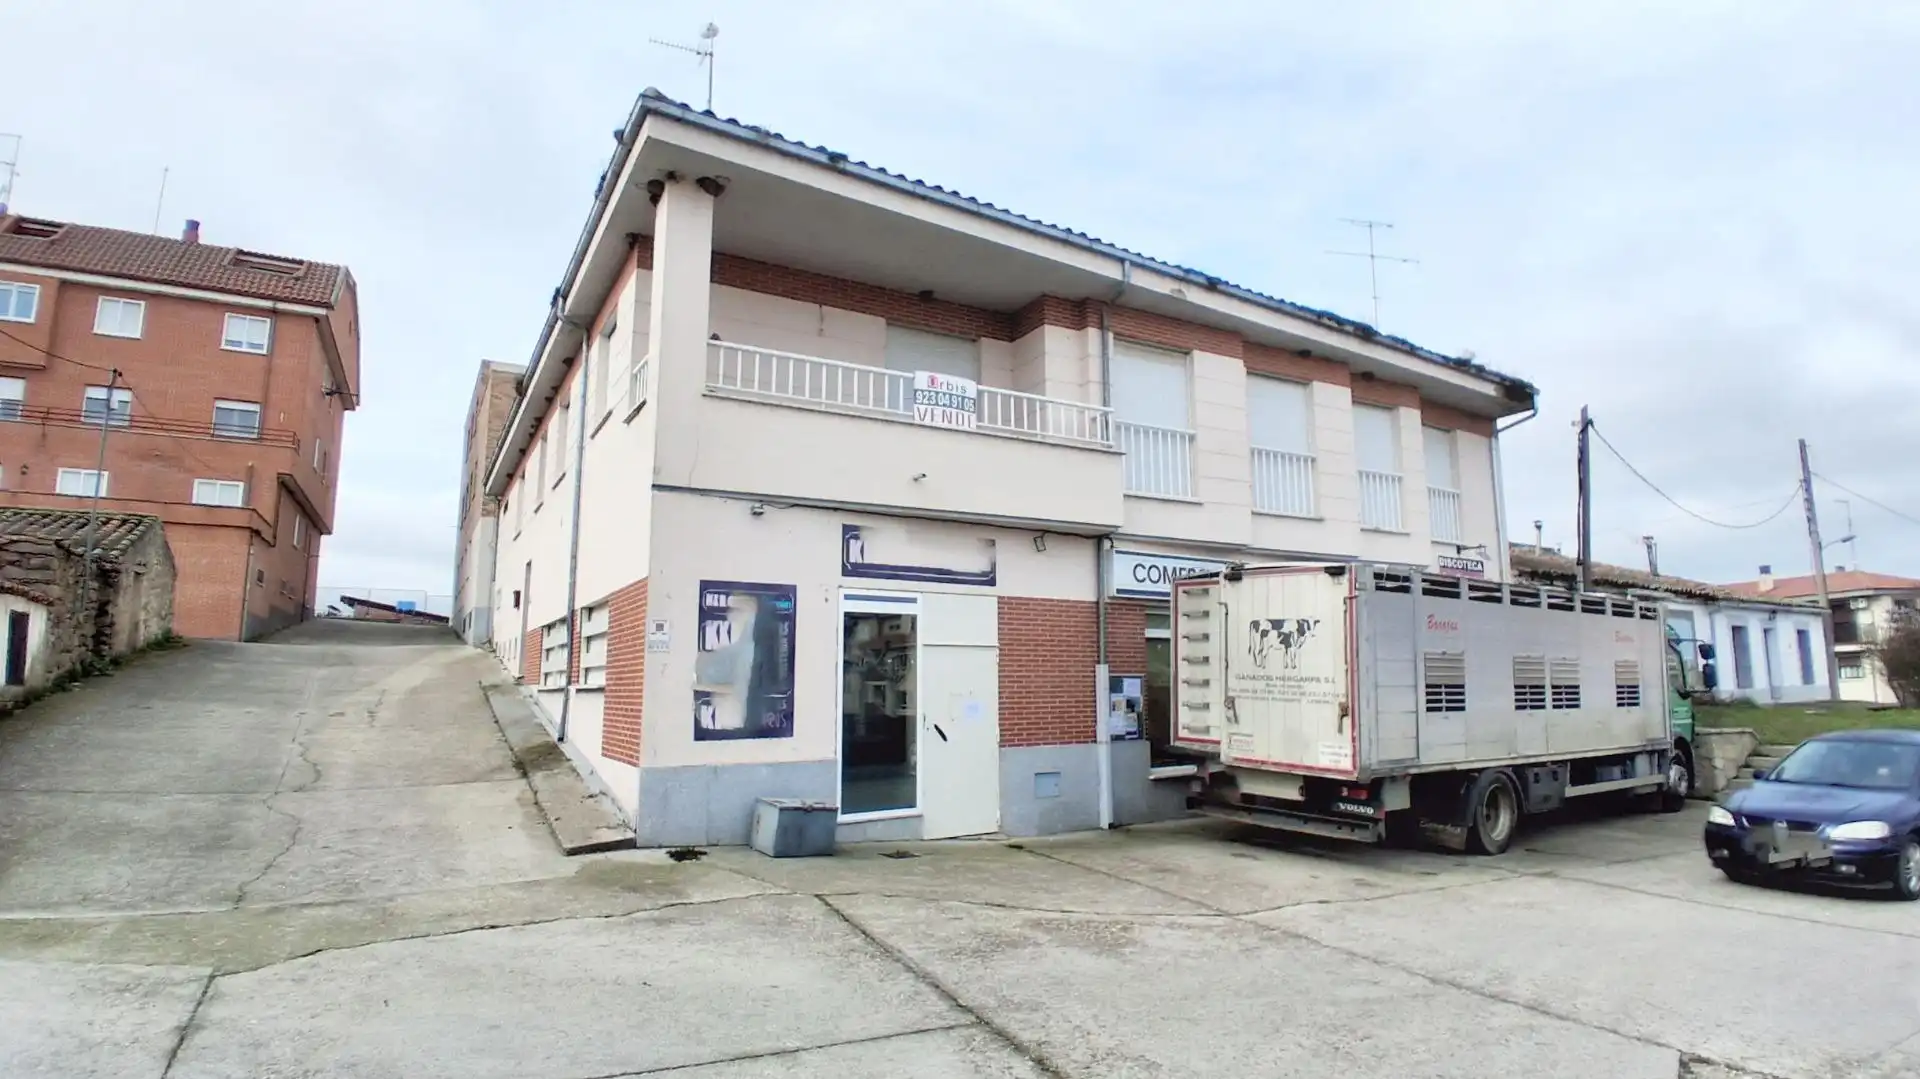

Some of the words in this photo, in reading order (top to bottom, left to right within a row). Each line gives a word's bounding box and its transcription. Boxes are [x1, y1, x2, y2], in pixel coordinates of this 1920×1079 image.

[915, 390, 937, 405] 923
[937, 392, 950, 407] 04
[951, 394, 962, 410] 91
[1440, 556, 1484, 572] DISCOTECA
[1235, 673, 1274, 682] GANADOS
[1338, 802, 1375, 815] VOLVO
